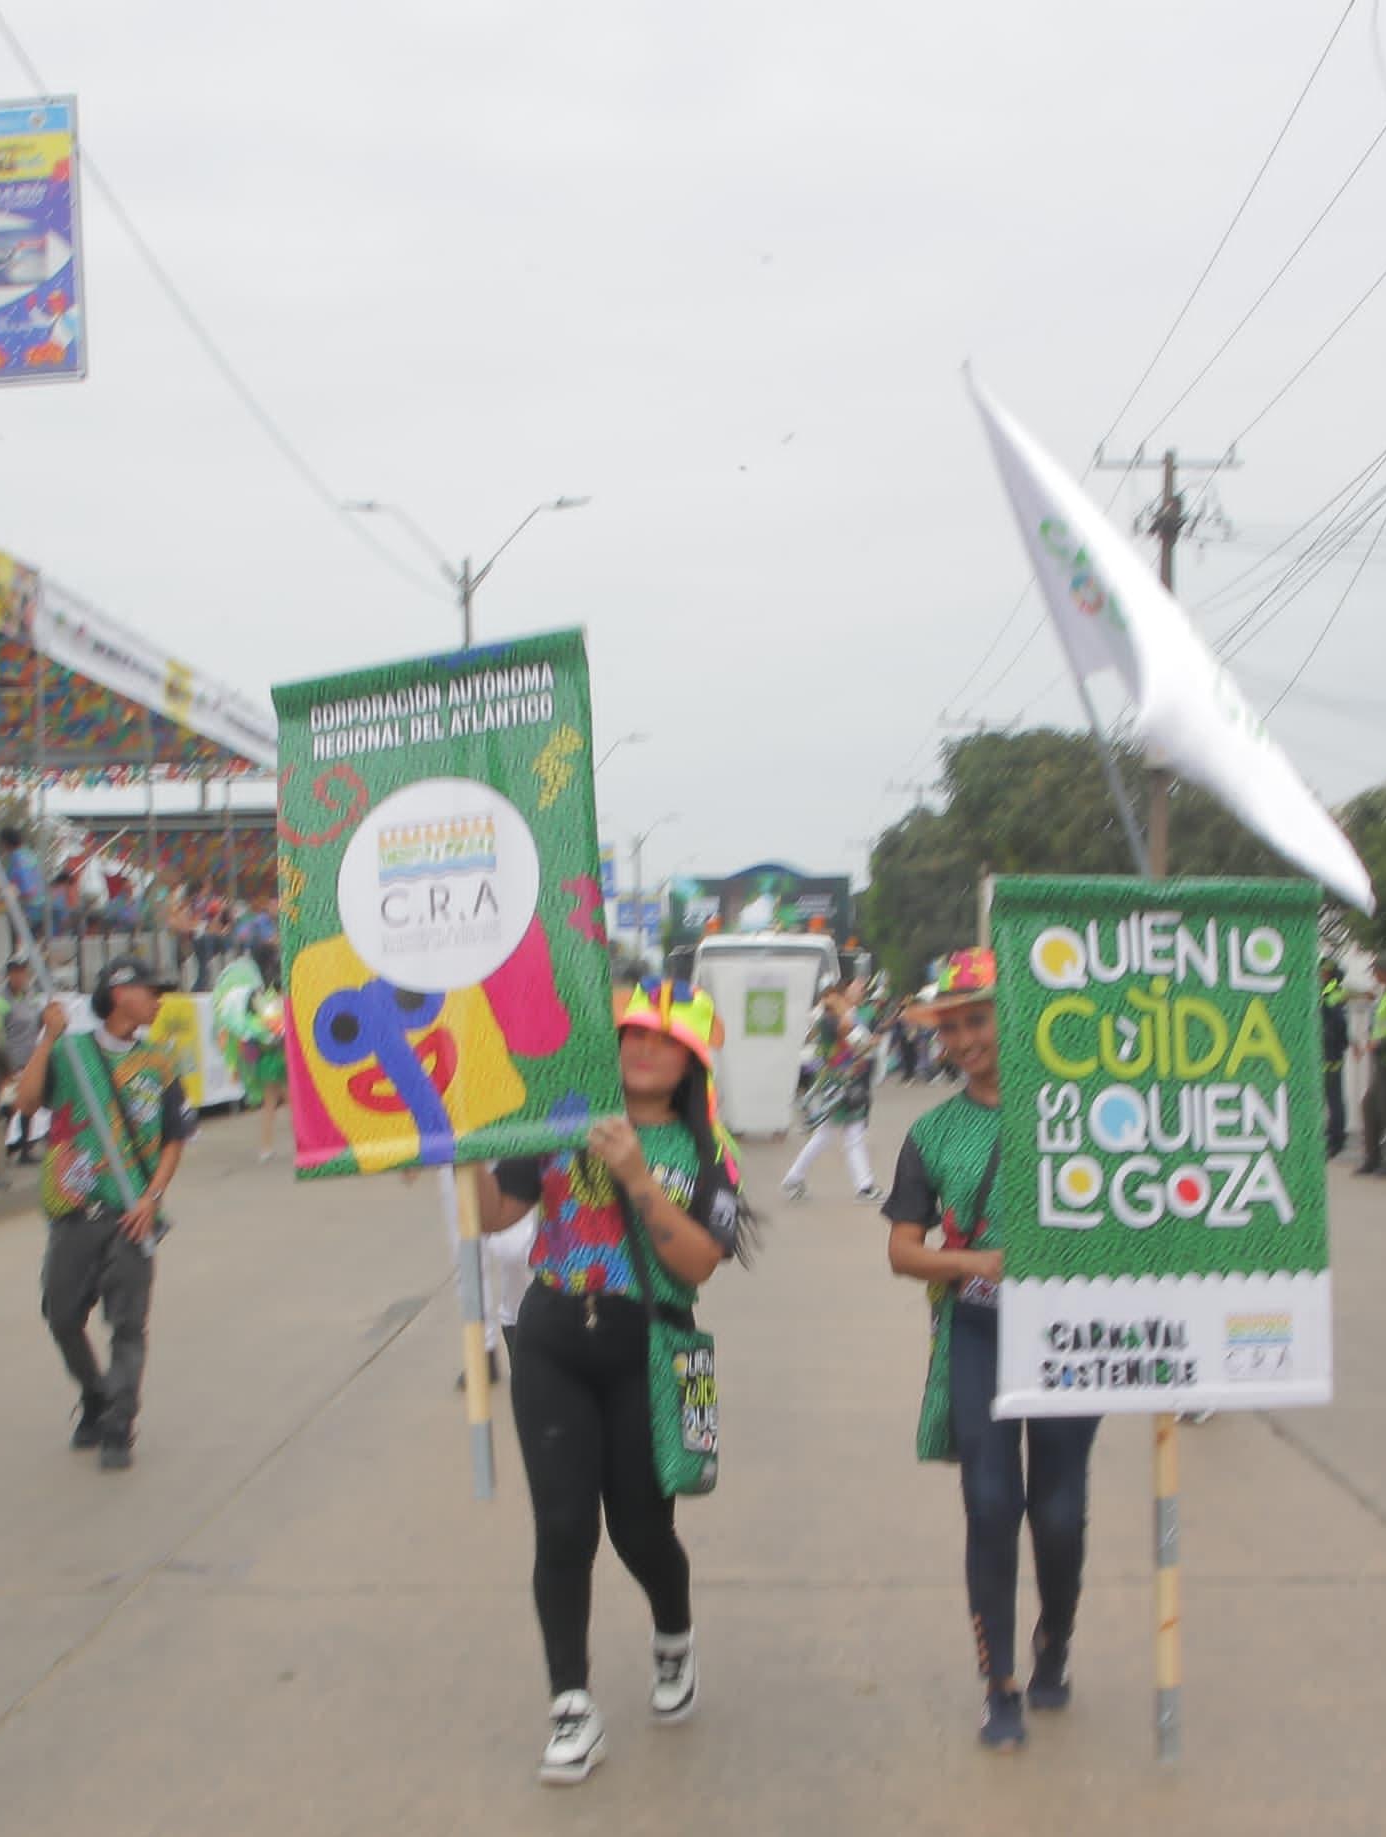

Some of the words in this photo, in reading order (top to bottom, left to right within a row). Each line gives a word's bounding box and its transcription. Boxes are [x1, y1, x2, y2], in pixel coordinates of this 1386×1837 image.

[310, 680, 441, 732] CORPORACIÓN
[449, 660, 555, 707] AUTÓNOMA
[313, 717, 405, 762] REGIONAL
[410, 710, 445, 745] DEL
[1029, 910, 1220, 990] QUIEN
[1227, 926, 1288, 993] LO
[1035, 976, 1291, 1080] CUIDA
[1036, 1081, 1082, 1152] ES
[1088, 1081, 1291, 1153] QUIEN
[1038, 1155, 1104, 1230] LO
[1108, 1152, 1296, 1231] GOZA
[1040, 1357, 1199, 1390] SOSTENIBLE
